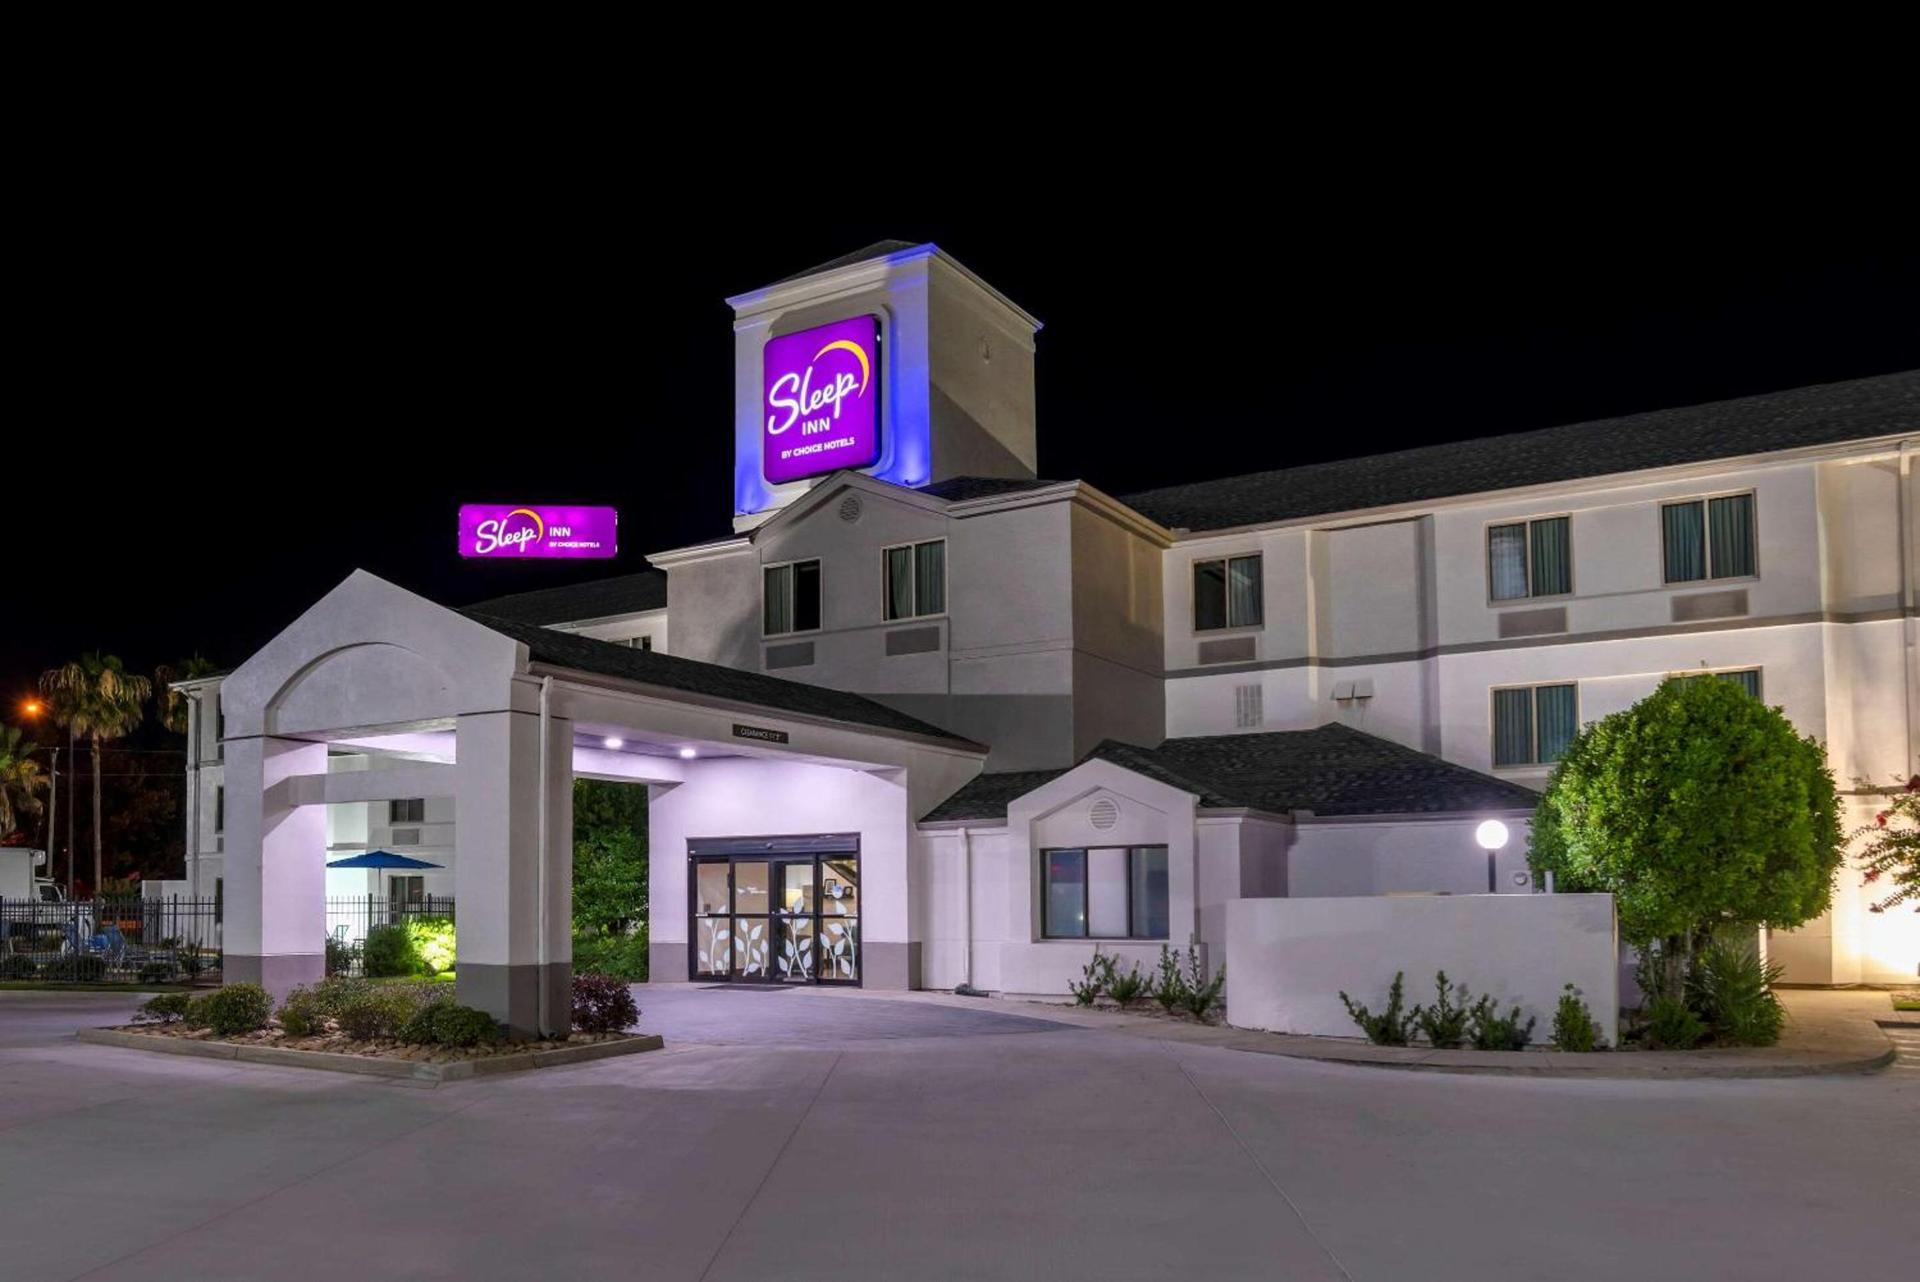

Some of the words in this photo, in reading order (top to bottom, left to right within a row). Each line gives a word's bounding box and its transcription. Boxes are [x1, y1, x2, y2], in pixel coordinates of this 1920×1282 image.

[767, 366, 859, 435] Sleep
[802, 417, 830, 436] INN
[781, 450, 792, 459] BY
[793, 445, 822, 457] CHOICE
[824, 437, 855, 450] HOTELS
[475, 519, 537, 554] Sleep
[549, 526, 571, 537] INN
